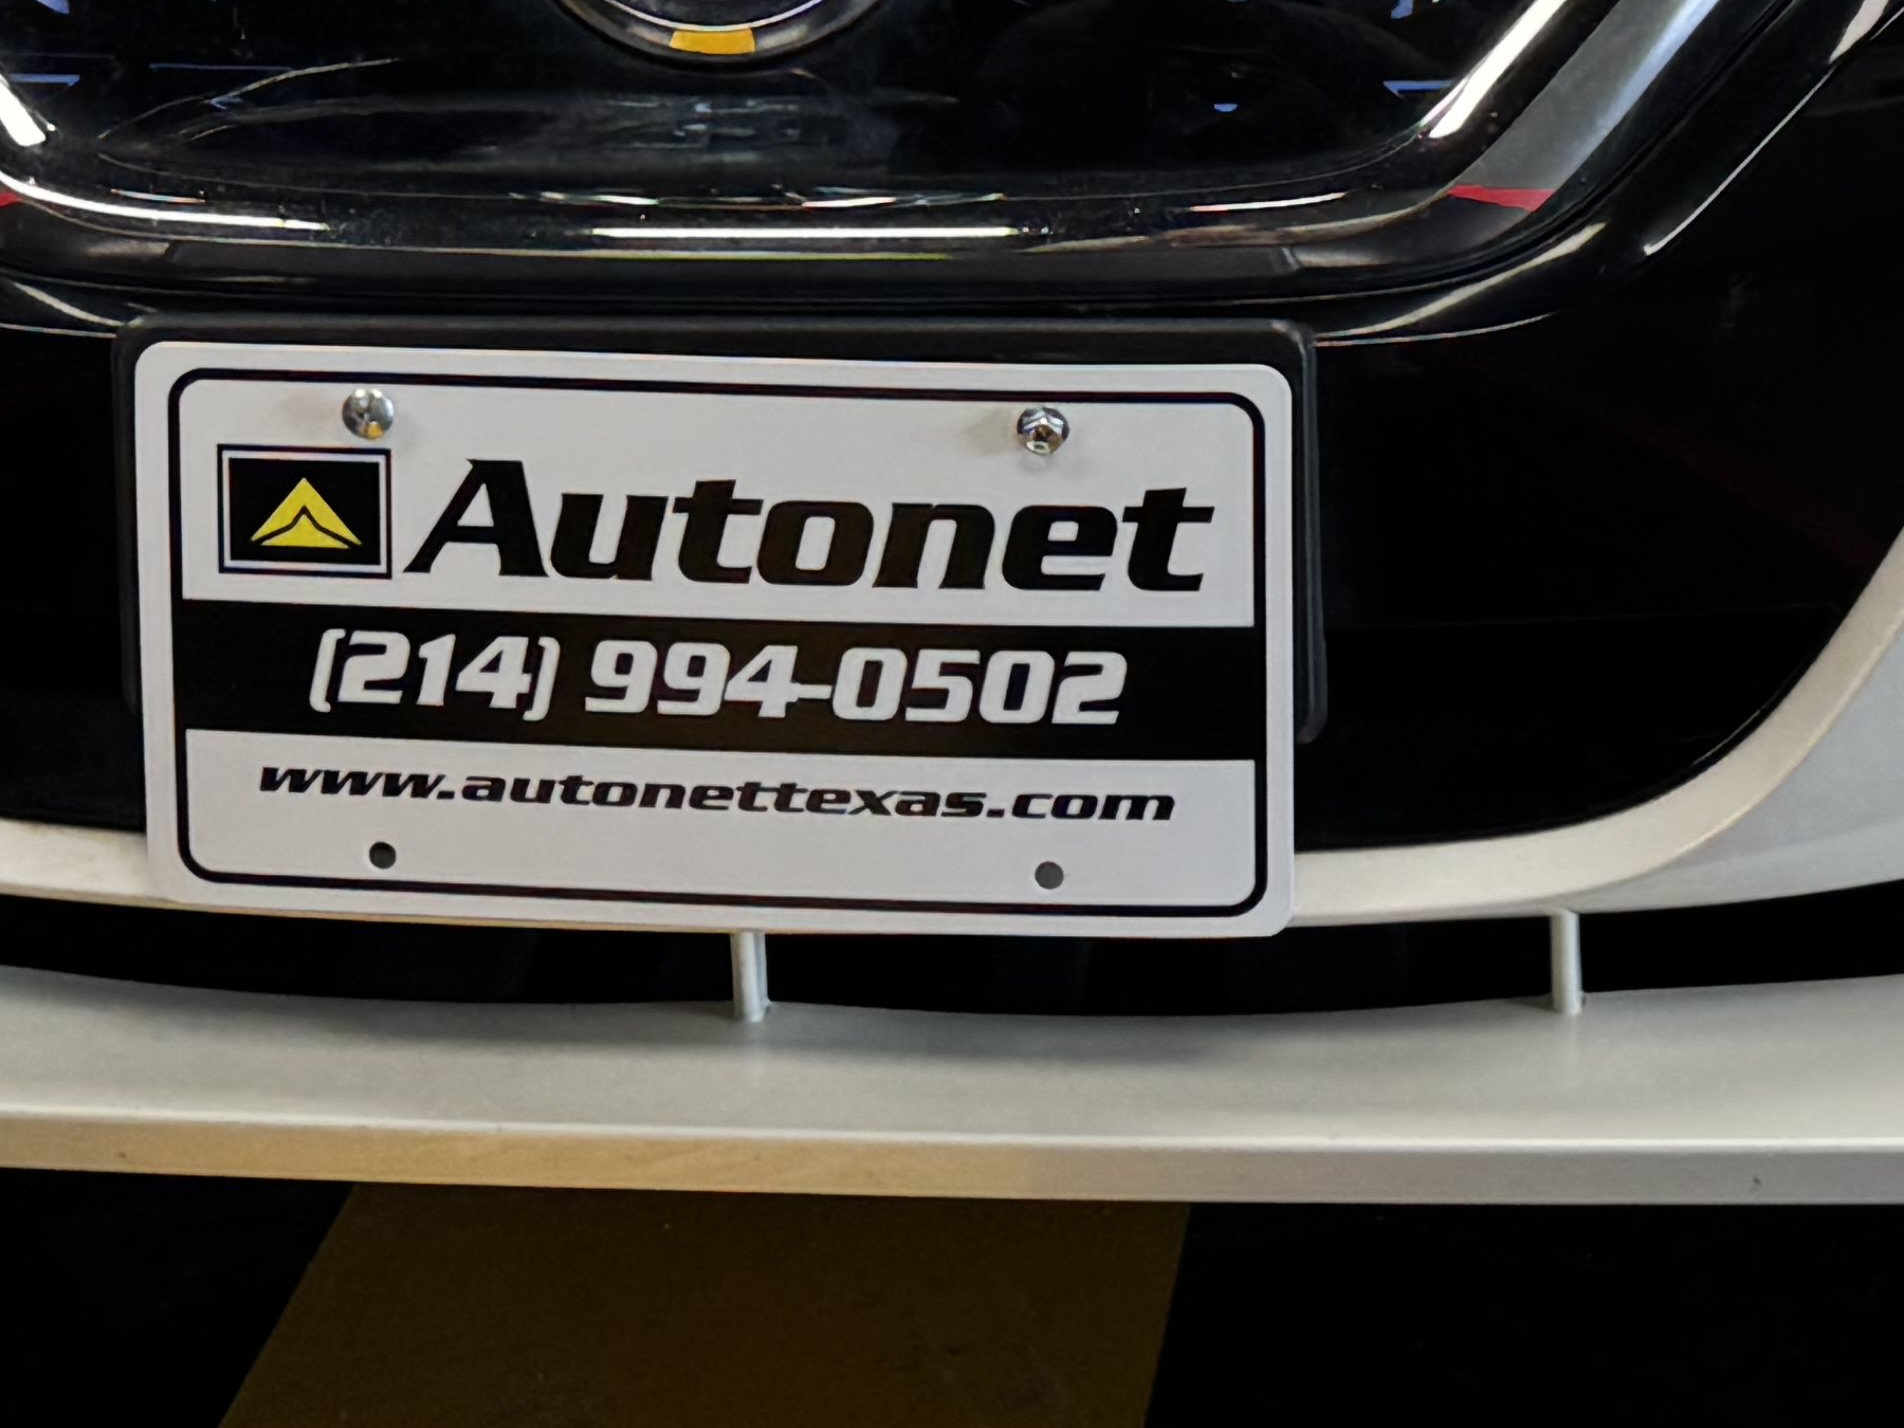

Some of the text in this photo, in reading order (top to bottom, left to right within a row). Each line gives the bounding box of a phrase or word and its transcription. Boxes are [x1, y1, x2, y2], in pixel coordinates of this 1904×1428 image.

[404, 459, 1215, 591] Autonet
[309, 628, 1129, 726] (214) 994-0502
[257, 764, 1178, 823] www.autonettexas.com
